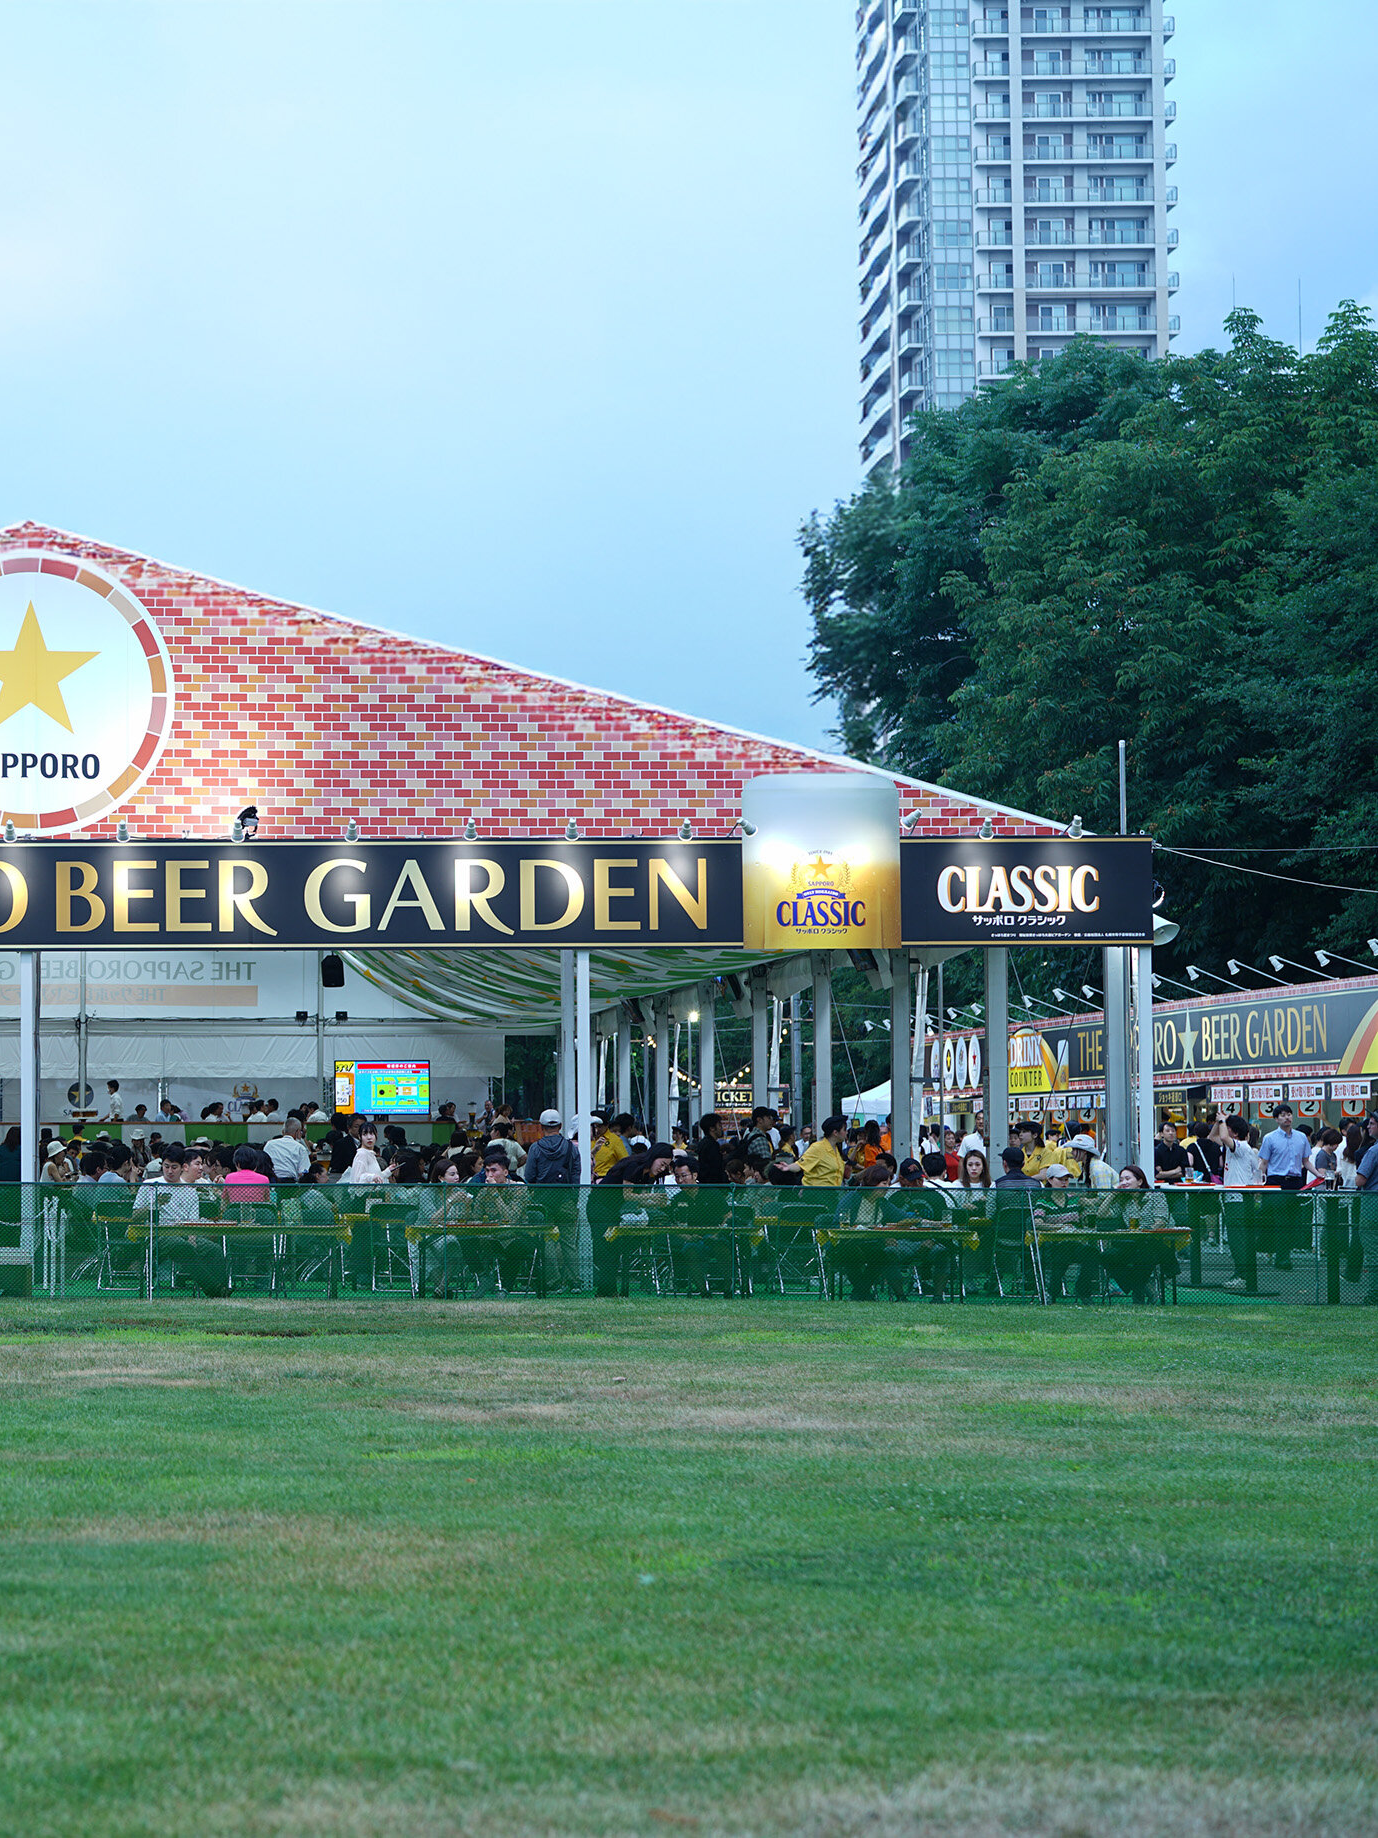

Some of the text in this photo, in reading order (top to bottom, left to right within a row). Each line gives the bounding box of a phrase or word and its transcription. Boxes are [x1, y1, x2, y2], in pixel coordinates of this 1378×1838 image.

[937, 864, 1099, 913] CLASSIC
[55, 860, 278, 937] BEER
[304, 858, 708, 937] GARDEN
[776, 900, 866, 927] CLASSIC
[972, 915, 1067, 926] サッポロ クラシック
[1201, 1012, 1243, 1062] BEER
[1246, 1003, 1328, 1059] GARDEN
[1010, 1034, 1043, 1069] DRINK
[1077, 1030, 1104, 1072] THE
[1010, 1070, 1043, 1087] COUNTER
[1334, 1084, 1360, 1097] 受け取り窓口
[1225, 1102, 1236, 1113] 4
[1264, 1102, 1274, 1113] 3
[1304, 1101, 1315, 1112] 2
[1349, 1100, 1356, 1112] 1
[1033, 1111, 1040, 1120] 2
[1083, 1110, 1091, 1120] 4
